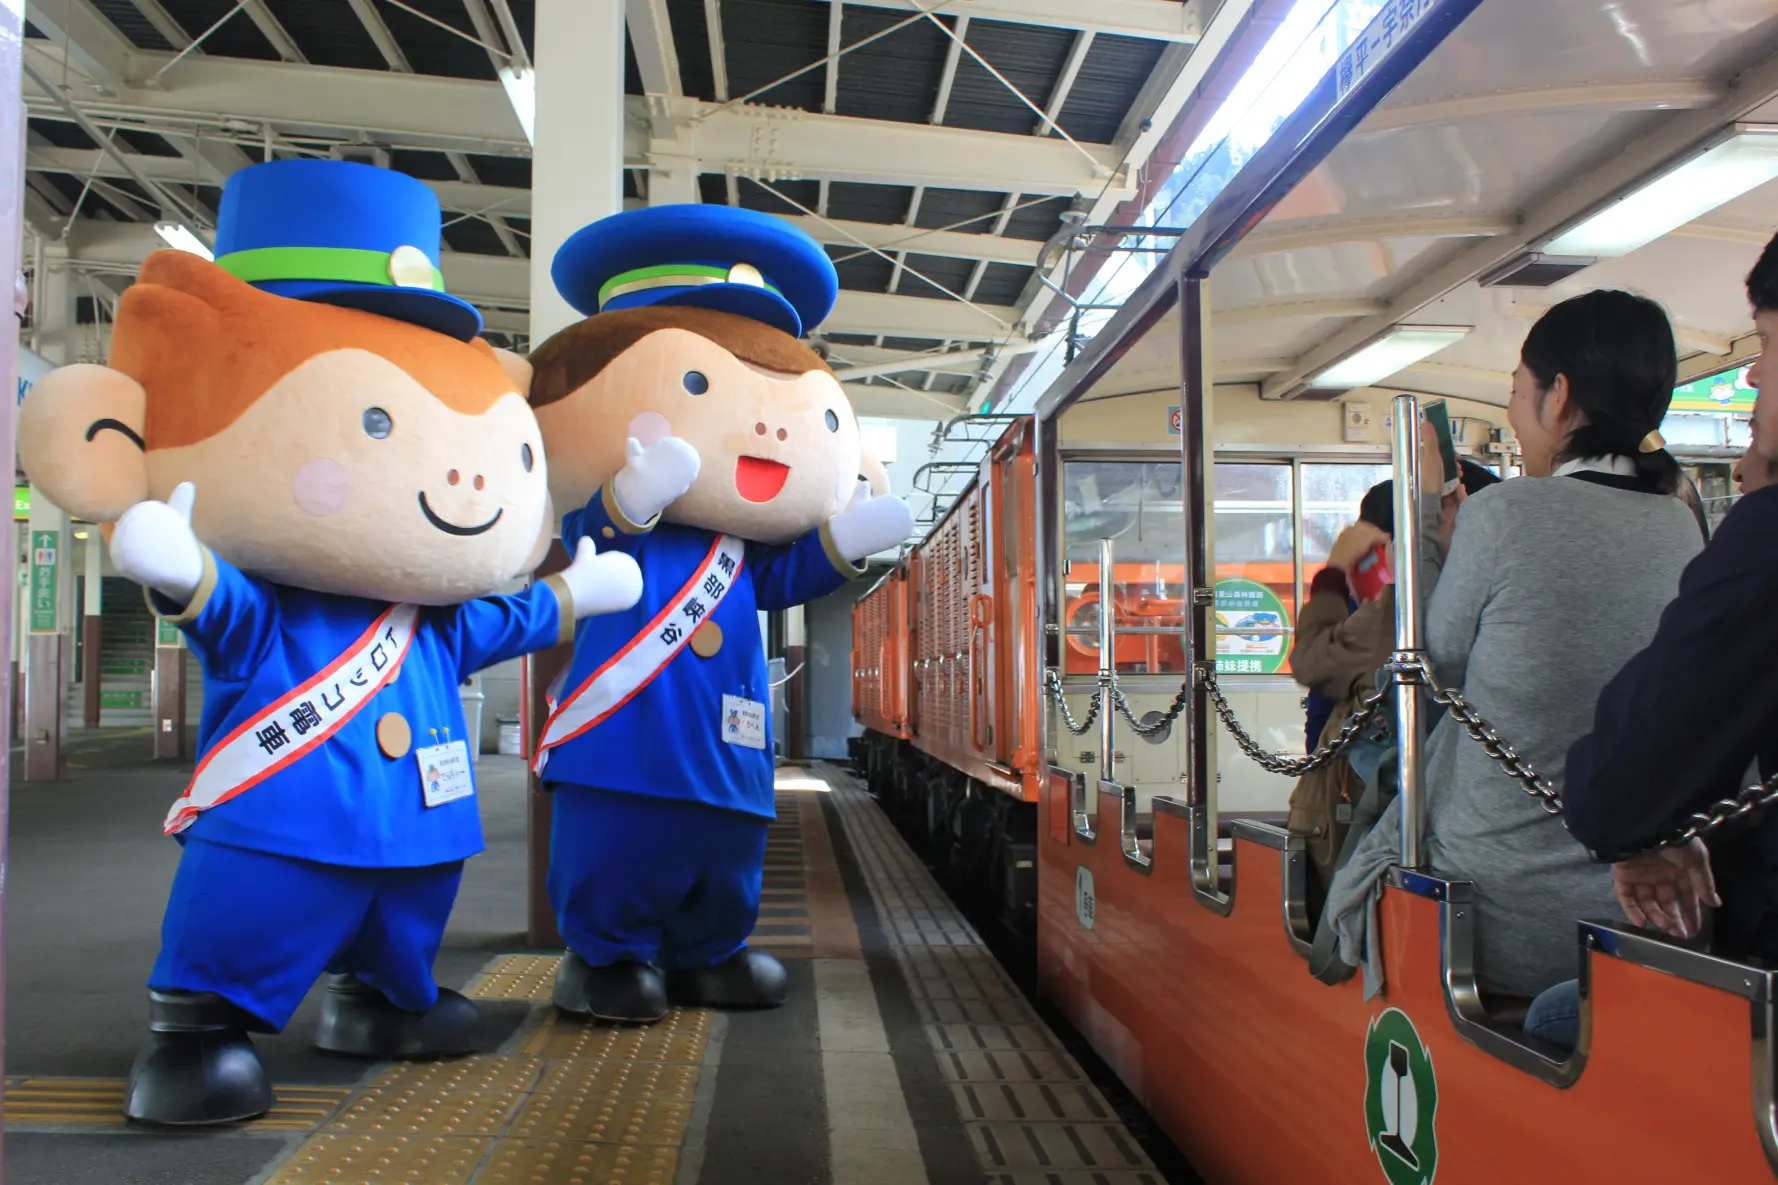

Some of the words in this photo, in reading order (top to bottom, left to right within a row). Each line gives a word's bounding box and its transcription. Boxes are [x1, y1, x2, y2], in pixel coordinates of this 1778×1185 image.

[660, 551, 736, 646] 黒部峡谷
[255, 626, 401, 756] トロッコ電車
